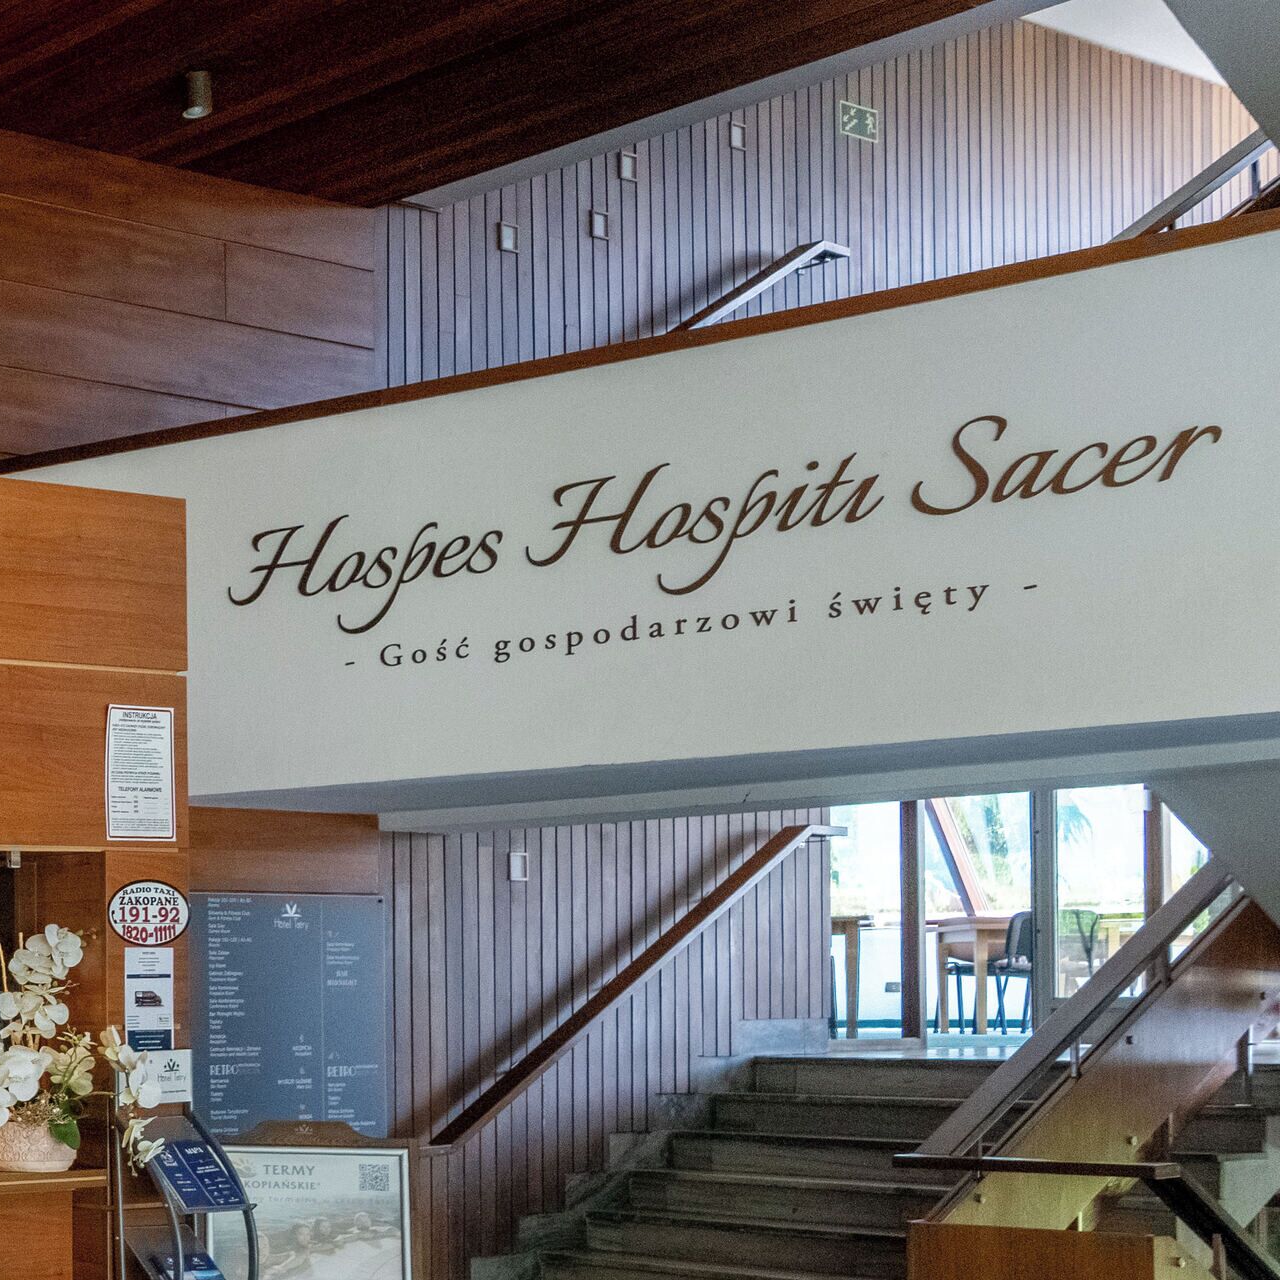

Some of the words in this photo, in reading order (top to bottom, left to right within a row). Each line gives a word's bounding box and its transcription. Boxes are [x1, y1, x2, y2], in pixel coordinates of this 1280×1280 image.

[228, 514, 504, 634] Hospes
[911, 415, 1223, 516] Sacer
[380, 636, 470, 667] Gość
[493, 598, 798, 664] gospodarzowi
[827, 583, 991, 620] święty
[122, 711, 157, 720] INSTRUKCJA
[122, 887, 152, 896] RADIO
[154, 887, 175, 896] TAXI
[119, 896, 179, 906] ZAKOPANE
[119, 906, 180, 923] 191-92
[122, 925, 176, 942] 1820-11111
[209, 1064, 238, 1075] RETRO
[263, 1164, 315, 1176] TERMY
[244, 1180, 317, 1190] KOPIAŃSKIE
